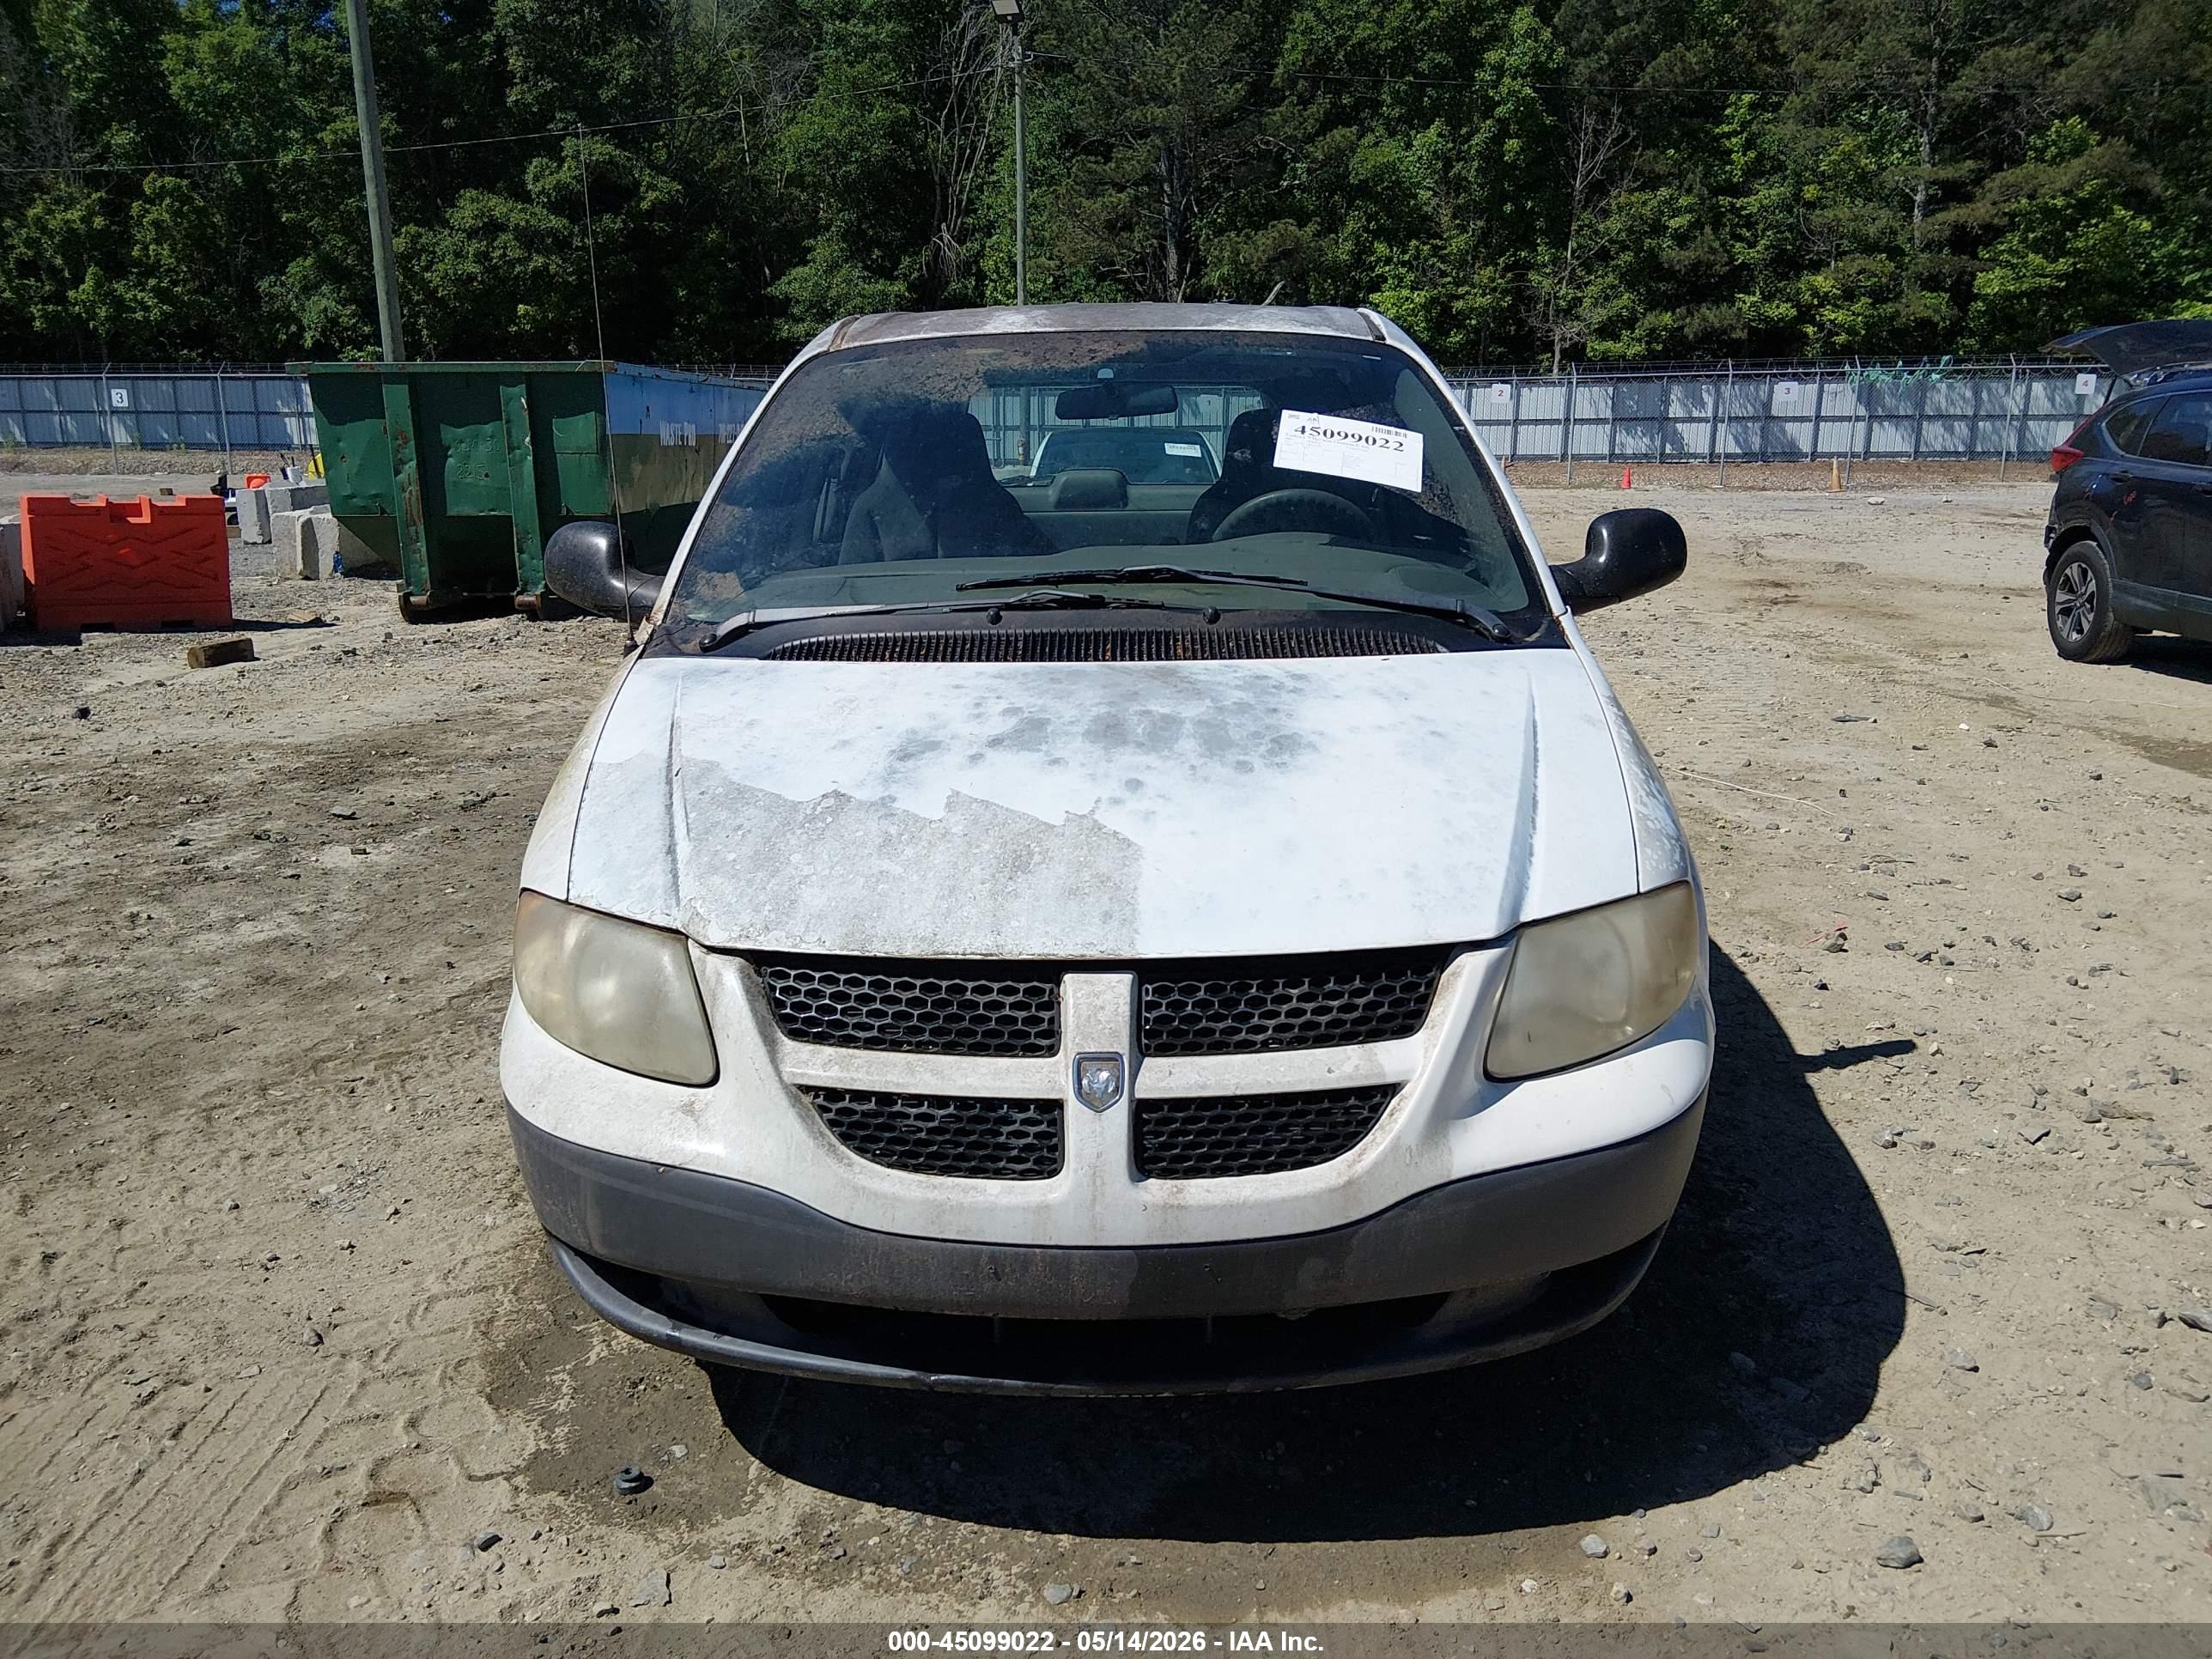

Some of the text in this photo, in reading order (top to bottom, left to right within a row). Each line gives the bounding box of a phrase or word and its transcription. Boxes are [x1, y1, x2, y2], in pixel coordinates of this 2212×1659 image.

[115, 392, 124, 404] 3
[659, 420, 682, 447] WASTE
[1294, 425, 1405, 453] 45099022
